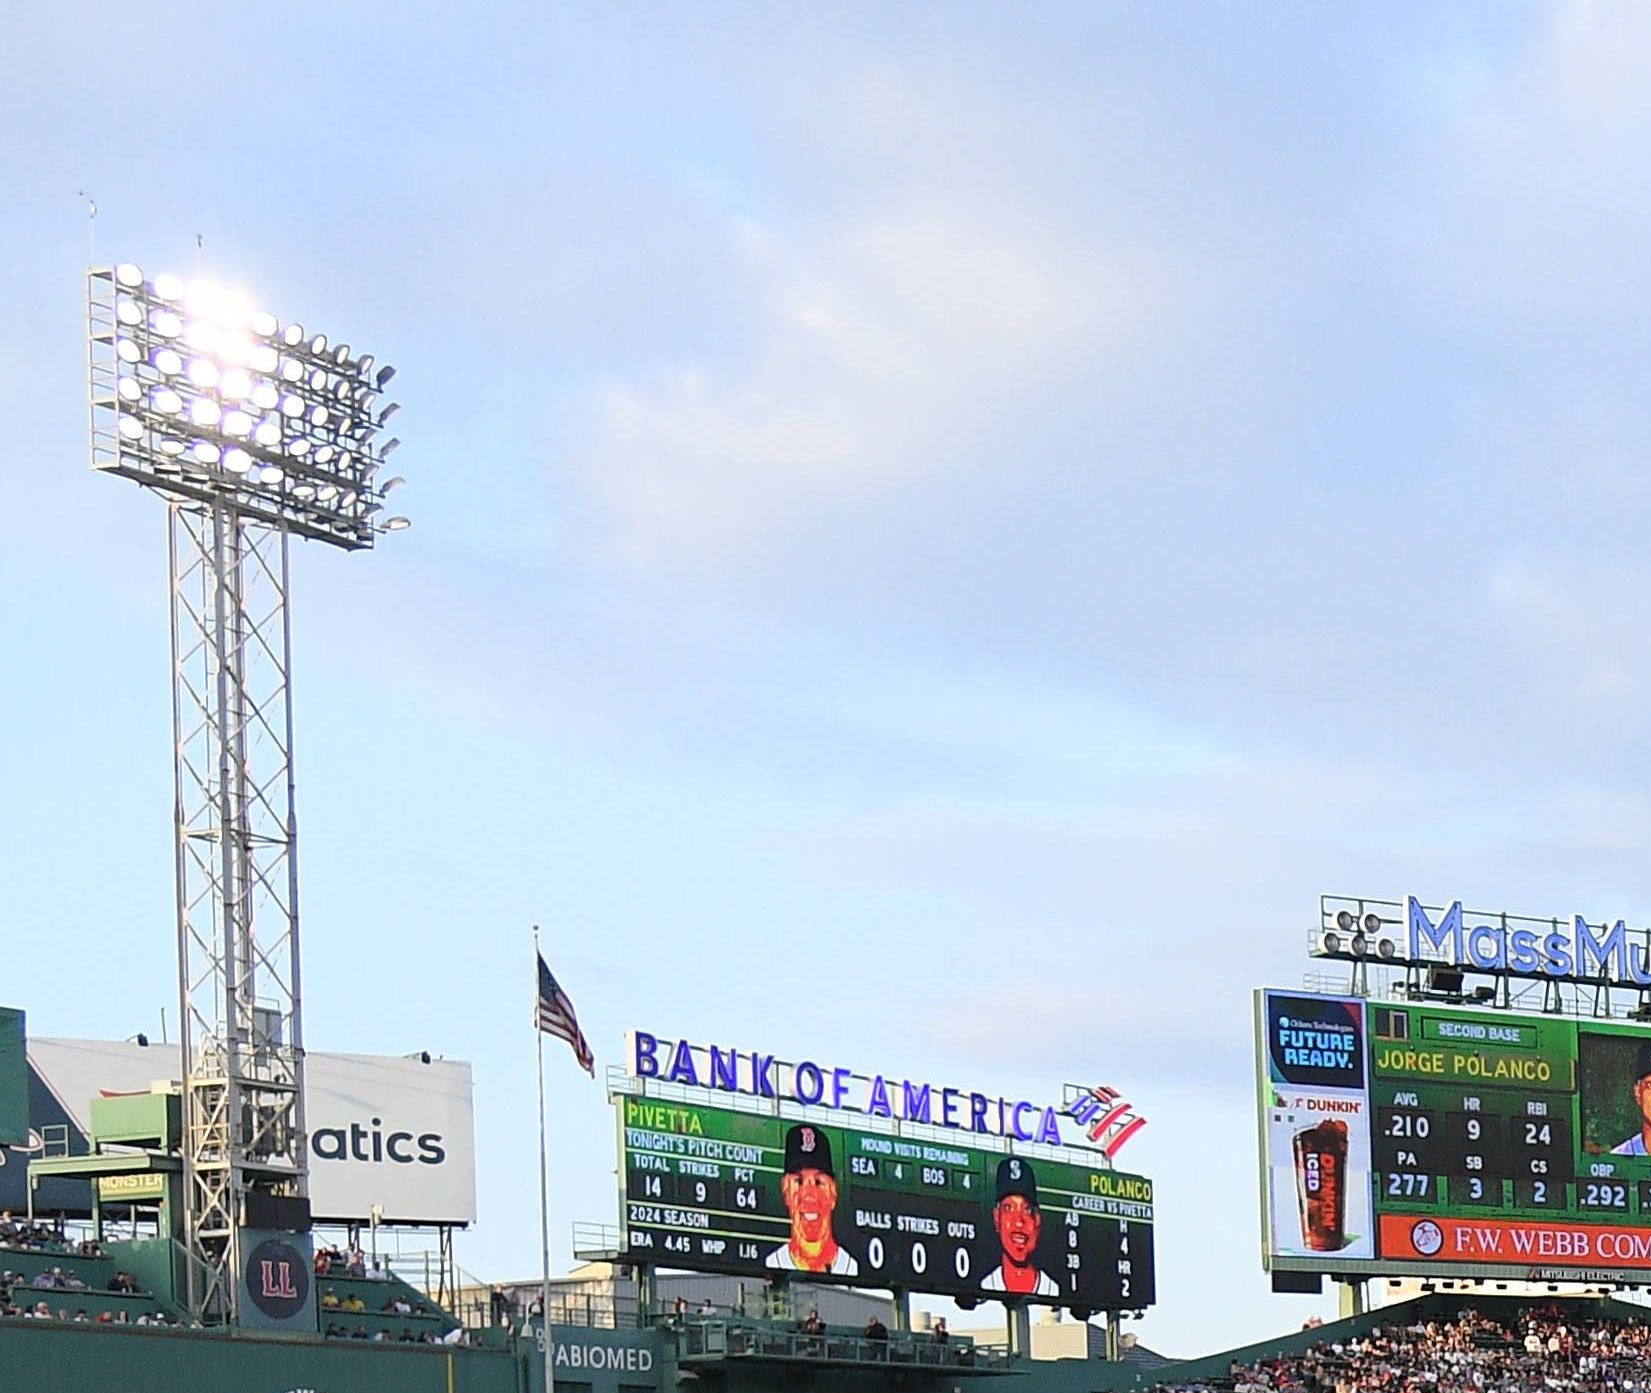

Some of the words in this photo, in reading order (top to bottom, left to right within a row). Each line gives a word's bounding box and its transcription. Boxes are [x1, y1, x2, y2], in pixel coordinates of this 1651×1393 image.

[1279, 1029, 1356, 1051] FUTURE
[1438, 1022, 1487, 1040] SECOND
[1488, 1026, 1521, 1042] BASE
[1284, 1047, 1354, 1069] READY.
[1377, 1050, 1445, 1074] JORGE
[1453, 1054, 1551, 1081] POLANCO
[632, 1029, 777, 1098] BANK
[793, 1060, 851, 1109] OF
[867, 1074, 1064, 1146] AMERICA
[1393, 1092, 1419, 1108] AVG
[1463, 1097, 1481, 1112] HR
[1527, 1101, 1547, 1117] RBI
[626, 1102, 703, 1135] PIVETTA
[1384, 1114, 1430, 1139] .210
[1467, 1119, 1481, 1141] 9
[1524, 1123, 1551, 1146] 24
[634, 1153, 671, 1173] TOTAL
[678, 1160, 720, 1179] STRIKES
[851, 1156, 876, 1176] SEA
[923, 1168, 946, 1186] BOS
[1305, 1153, 1319, 1192] ICED
[1397, 1151, 1418, 1167] PA
[1530, 1159, 1548, 1175] CS
[98, 1174, 163, 1188] MONSTER
[645, 1175, 662, 1198] 14
[736, 1188, 757, 1209] 64
[1089, 1174, 1152, 1200] POLANCO
[1388, 1173, 1428, 1197] 277
[1469, 1177, 1483, 1199] 3
[1580, 1184, 1626, 1208] .292
[630, 1205, 661, 1222] 2024
[664, 1209, 710, 1228] SEASON
[856, 1209, 892, 1230] BALLS
[896, 1215, 940, 1236] STRIKES
[947, 1221, 976, 1240] OUTS
[1064, 1210, 1080, 1228] AB
[1454, 1226, 1504, 1255] F.W.
[1509, 1229, 1591, 1257] WEBB
[555, 1343, 654, 1372] ABIOMED
